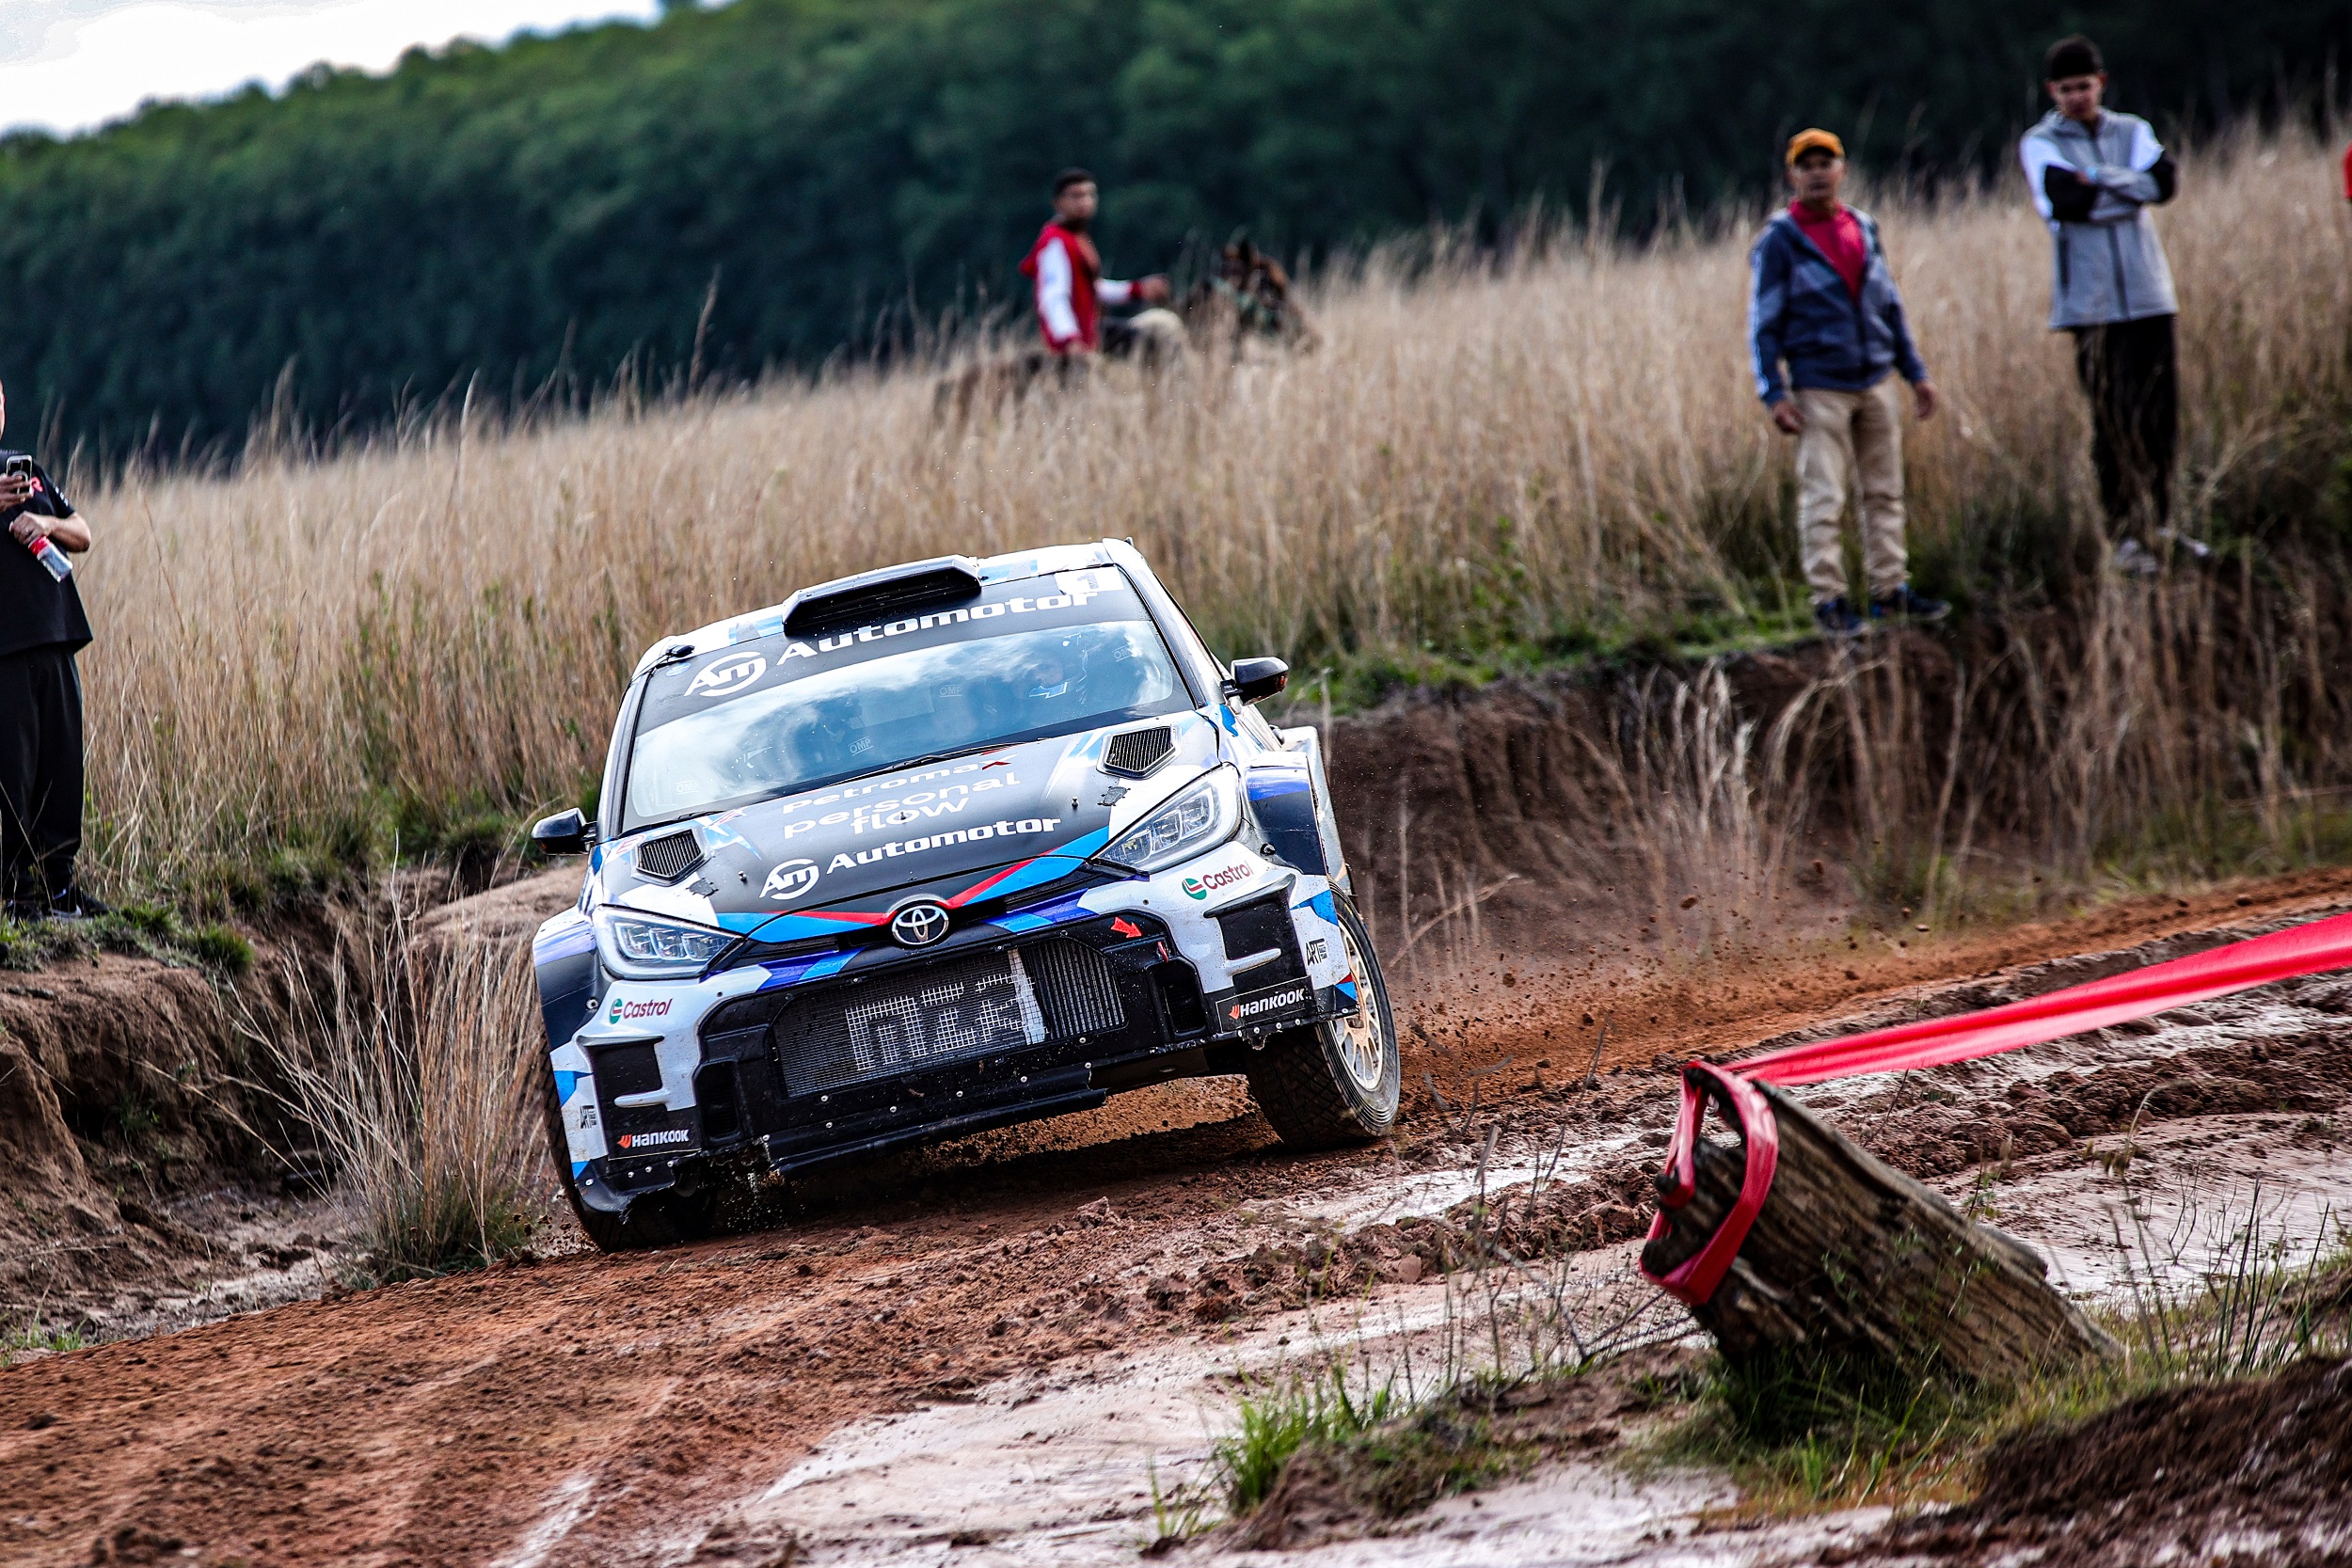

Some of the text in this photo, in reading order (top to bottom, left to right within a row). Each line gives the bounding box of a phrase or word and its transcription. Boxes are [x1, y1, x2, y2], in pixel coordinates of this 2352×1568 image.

[776, 592, 1098, 666] Automotor
[850, 738, 872, 753] OMP
[784, 772, 1021, 840] personal
[850, 798, 970, 835] flow
[826, 818, 1061, 875] Automotor
[1202, 860, 1255, 890] Castrol
[623, 998, 673, 1020] Castrol
